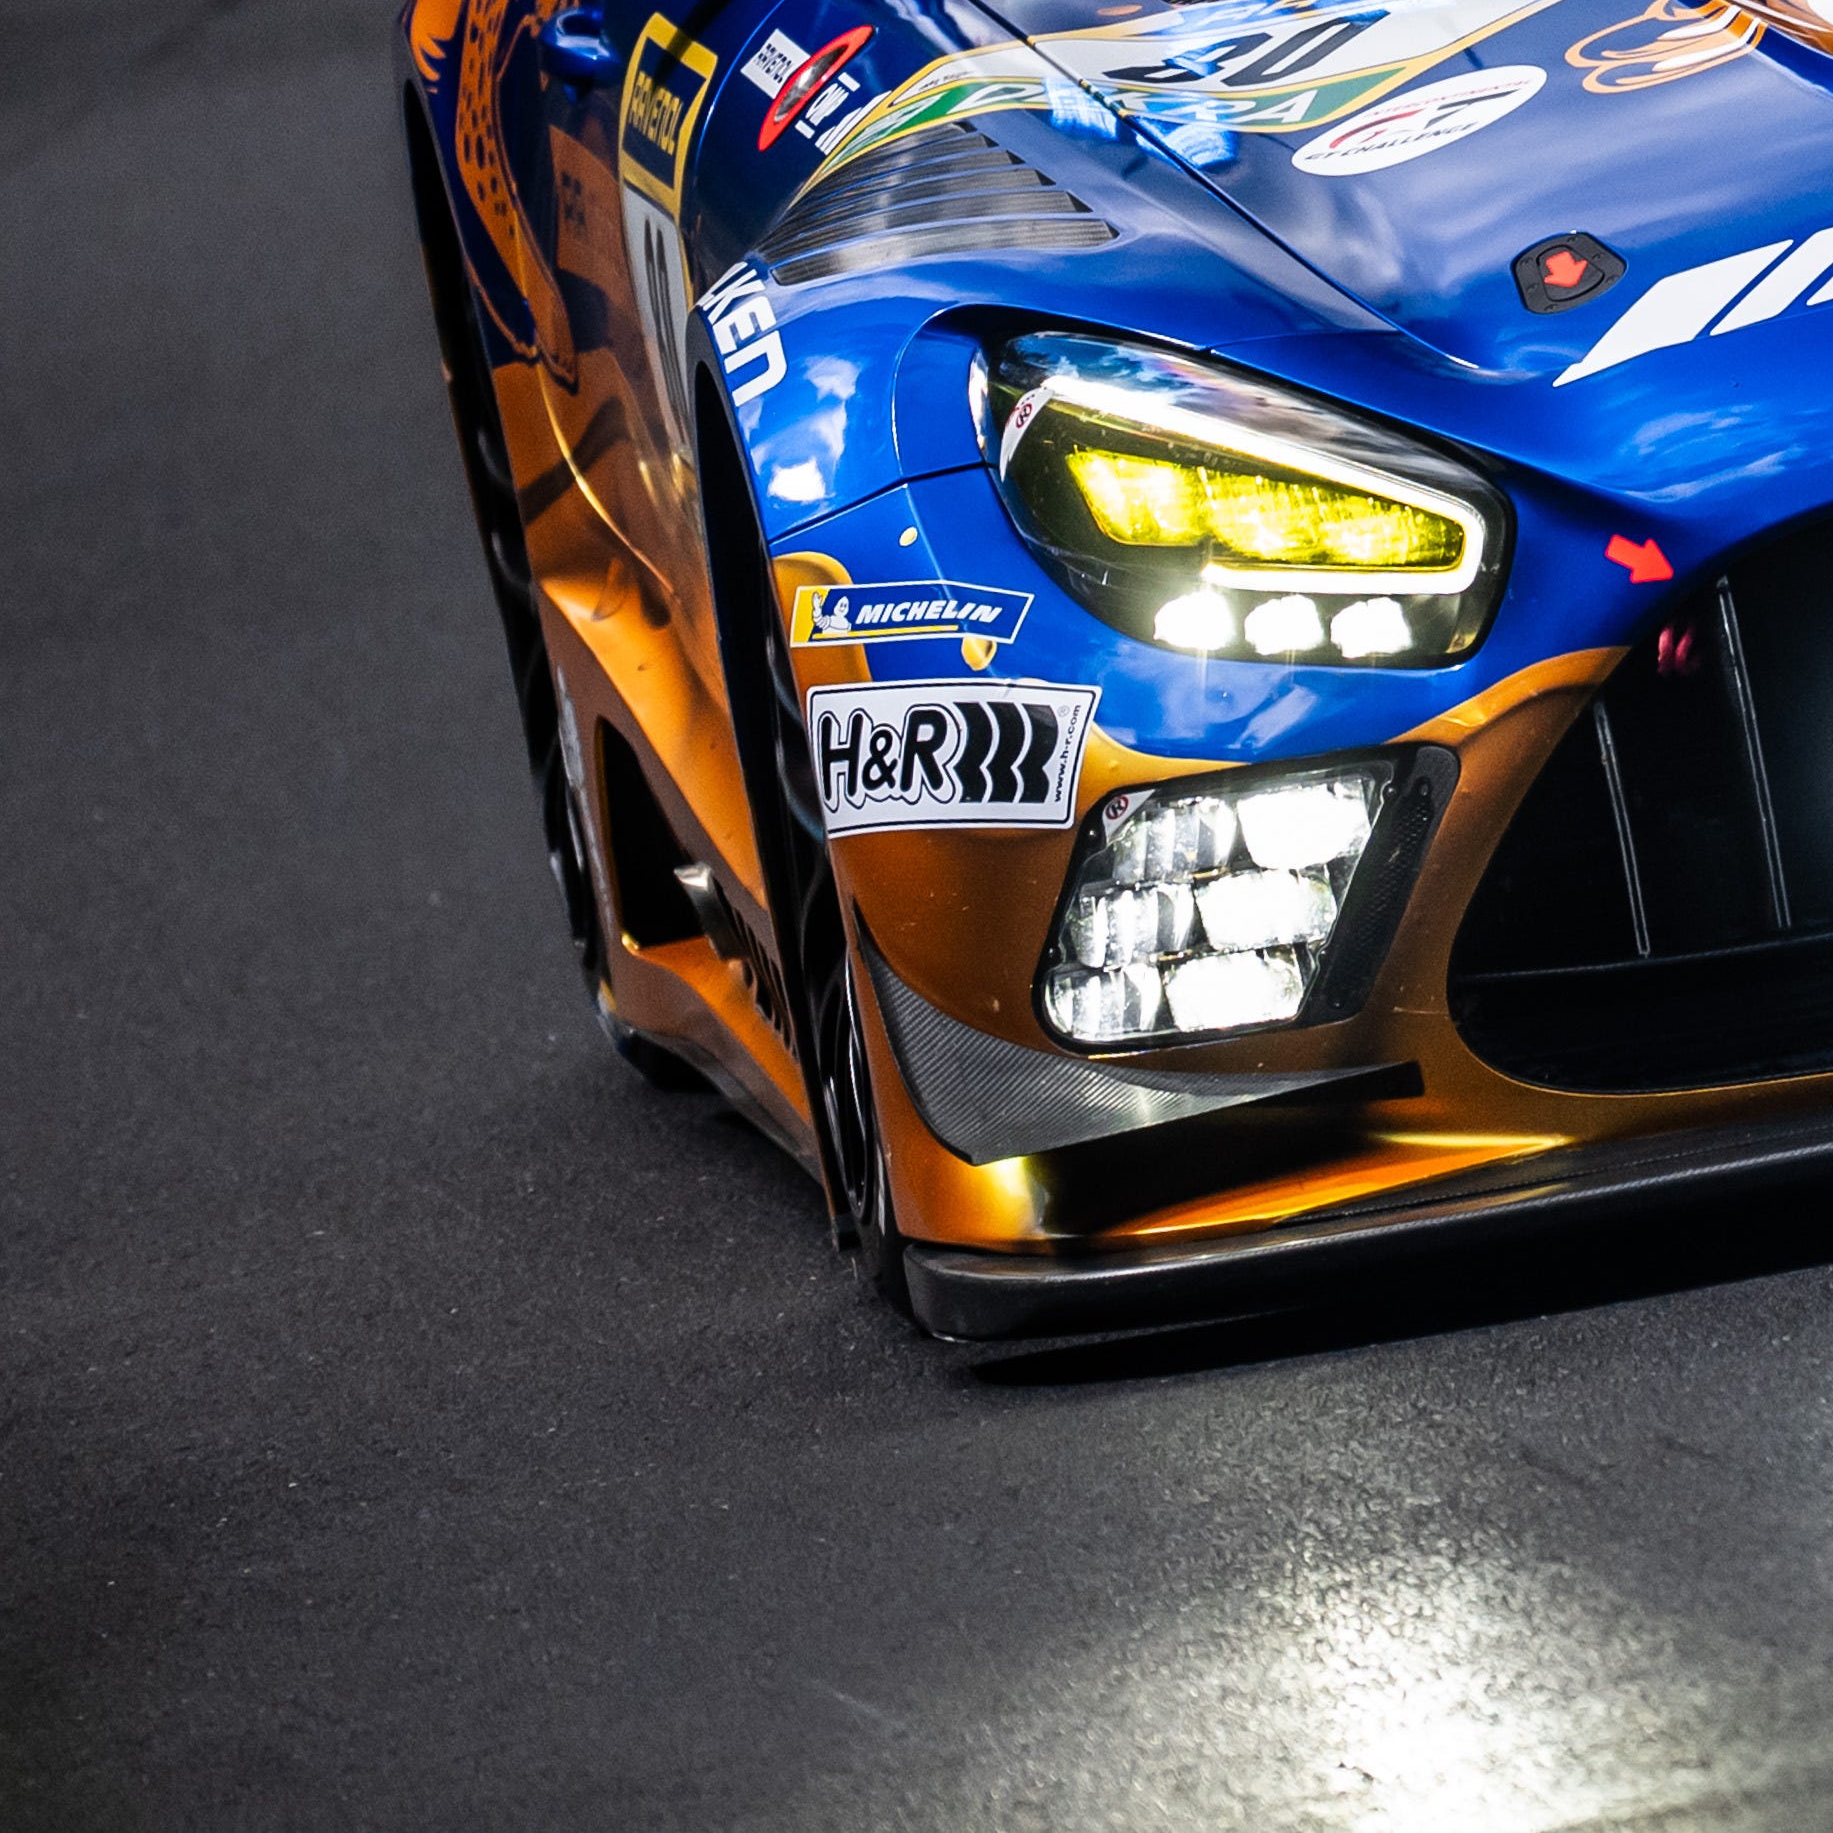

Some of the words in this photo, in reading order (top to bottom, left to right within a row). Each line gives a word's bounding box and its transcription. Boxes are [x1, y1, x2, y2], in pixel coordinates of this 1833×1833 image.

[628, 70, 684, 156] RAVENOL
[855, 598, 1002, 625] MICHELIN
[818, 706, 960, 808] H&R
[1053, 703, 1081, 803] www.h-r.com
